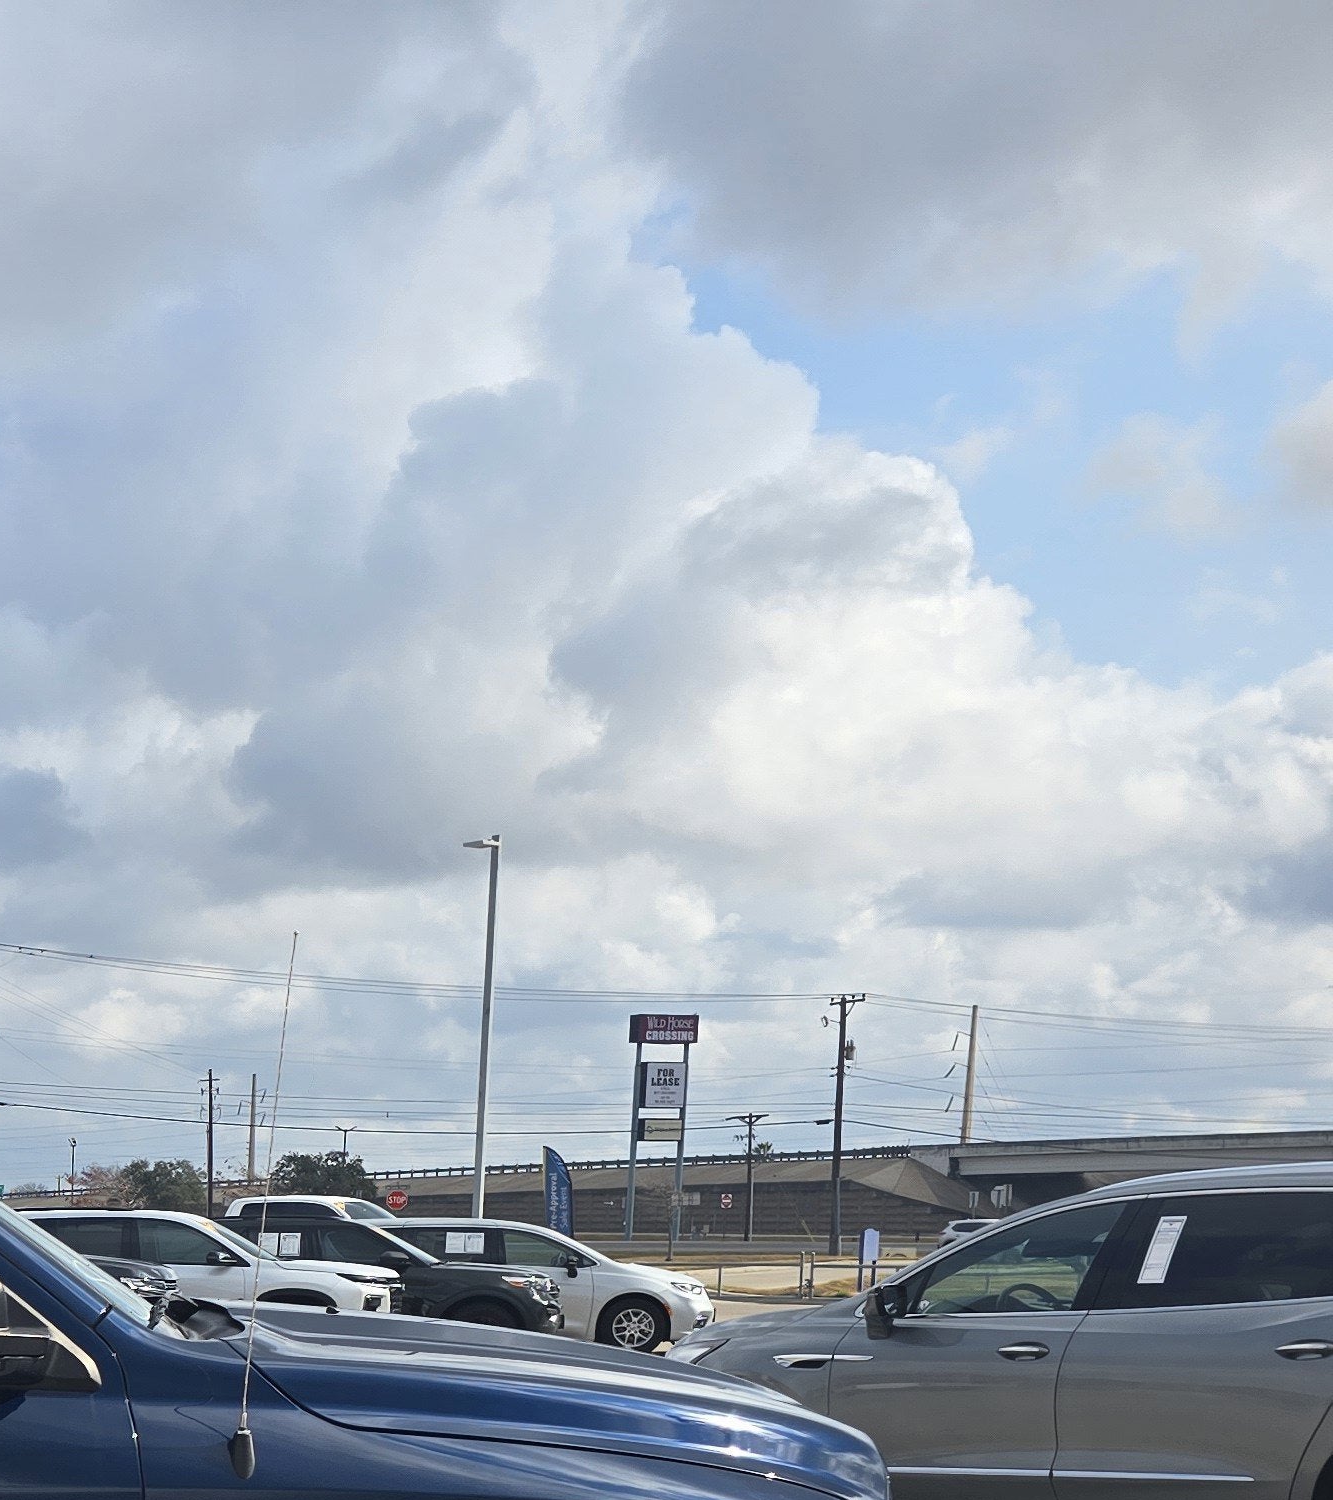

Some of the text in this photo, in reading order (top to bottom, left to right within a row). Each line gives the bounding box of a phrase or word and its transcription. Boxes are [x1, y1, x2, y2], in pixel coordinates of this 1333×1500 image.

[645, 1030, 694, 1041] CROSSING
[657, 1068, 675, 1078] FOR
[651, 1077, 680, 1087] LEASE
[388, 1195, 407, 1204] STOP
[548, 1172, 559, 1229] Pre-Approval
